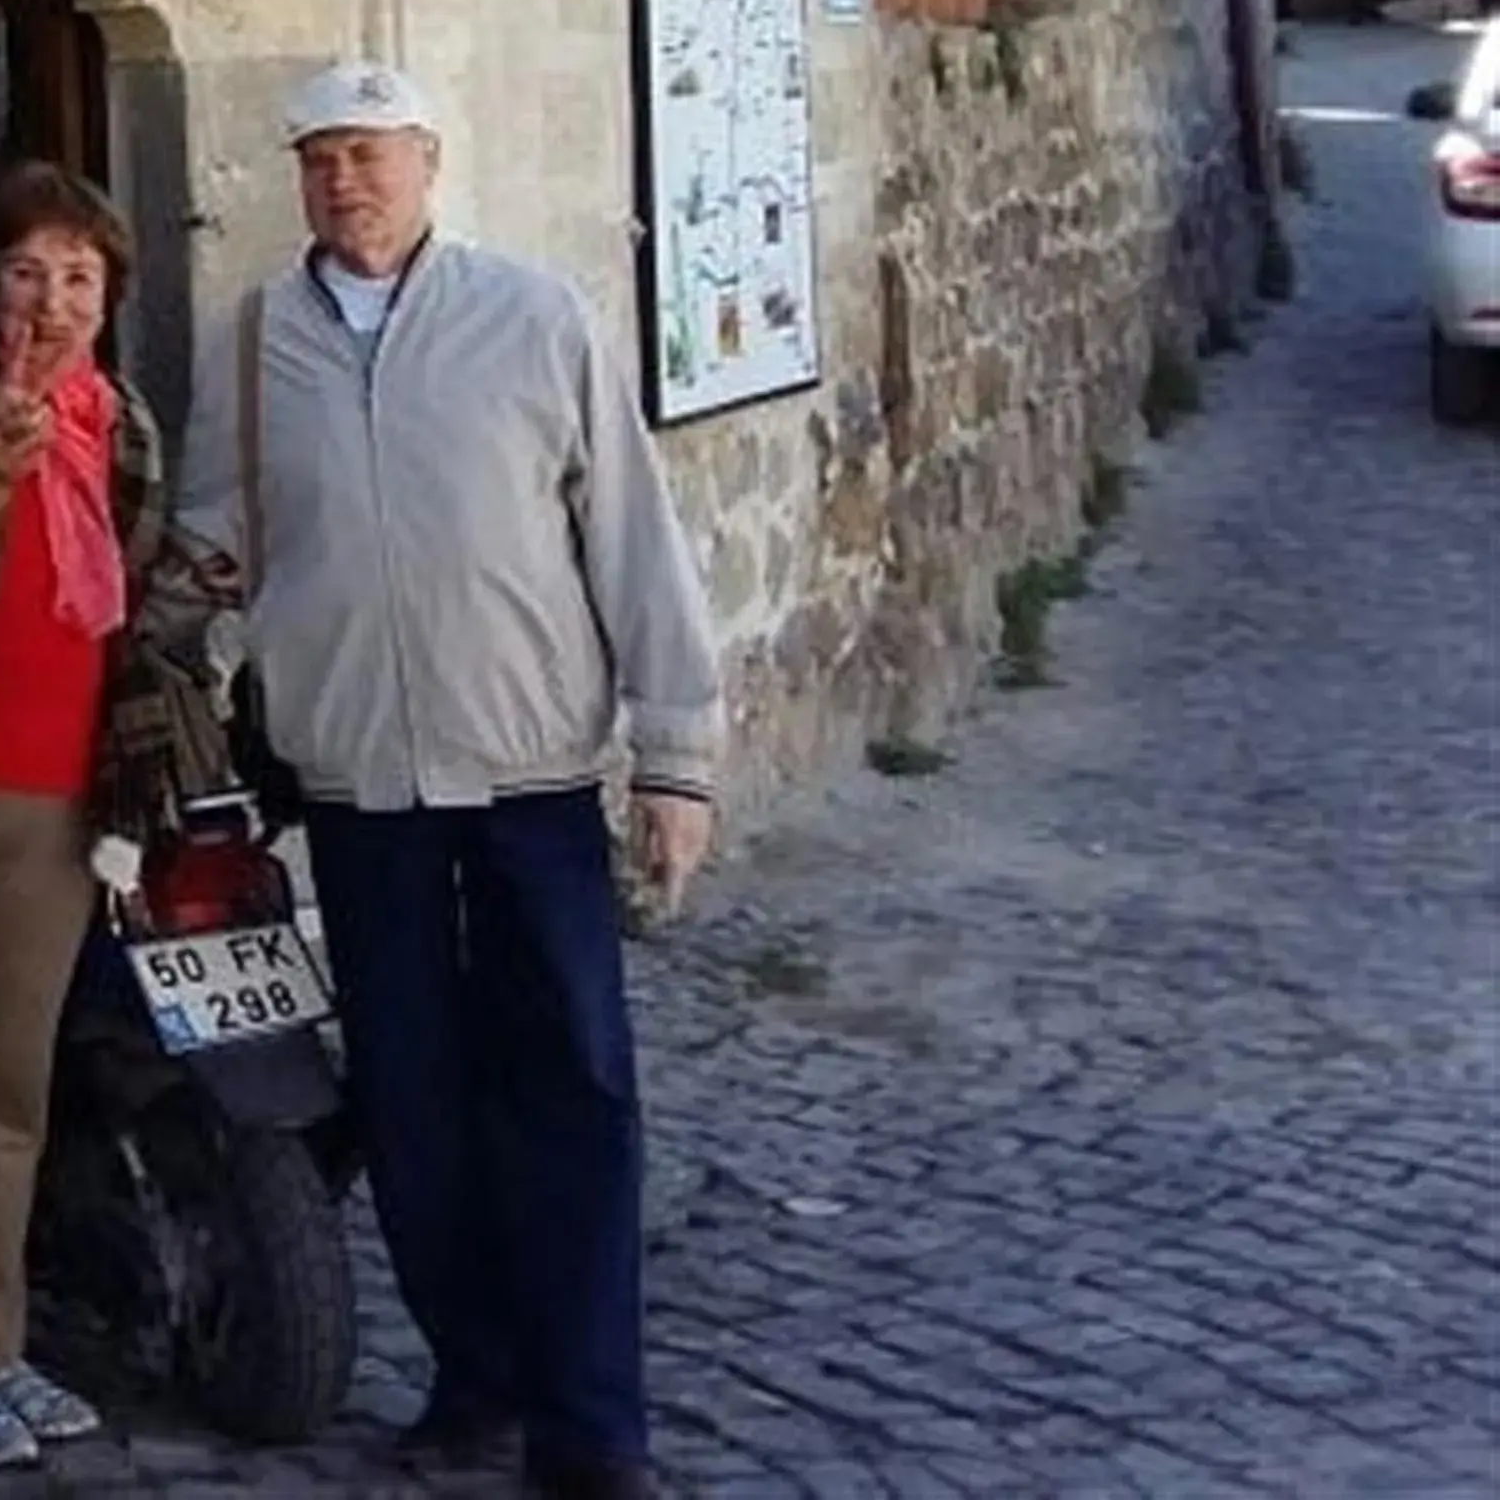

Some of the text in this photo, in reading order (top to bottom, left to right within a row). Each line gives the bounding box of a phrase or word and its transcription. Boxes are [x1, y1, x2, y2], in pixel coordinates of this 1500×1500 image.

[148, 931, 295, 988] 50 FK
[205, 980, 297, 1030] 298
